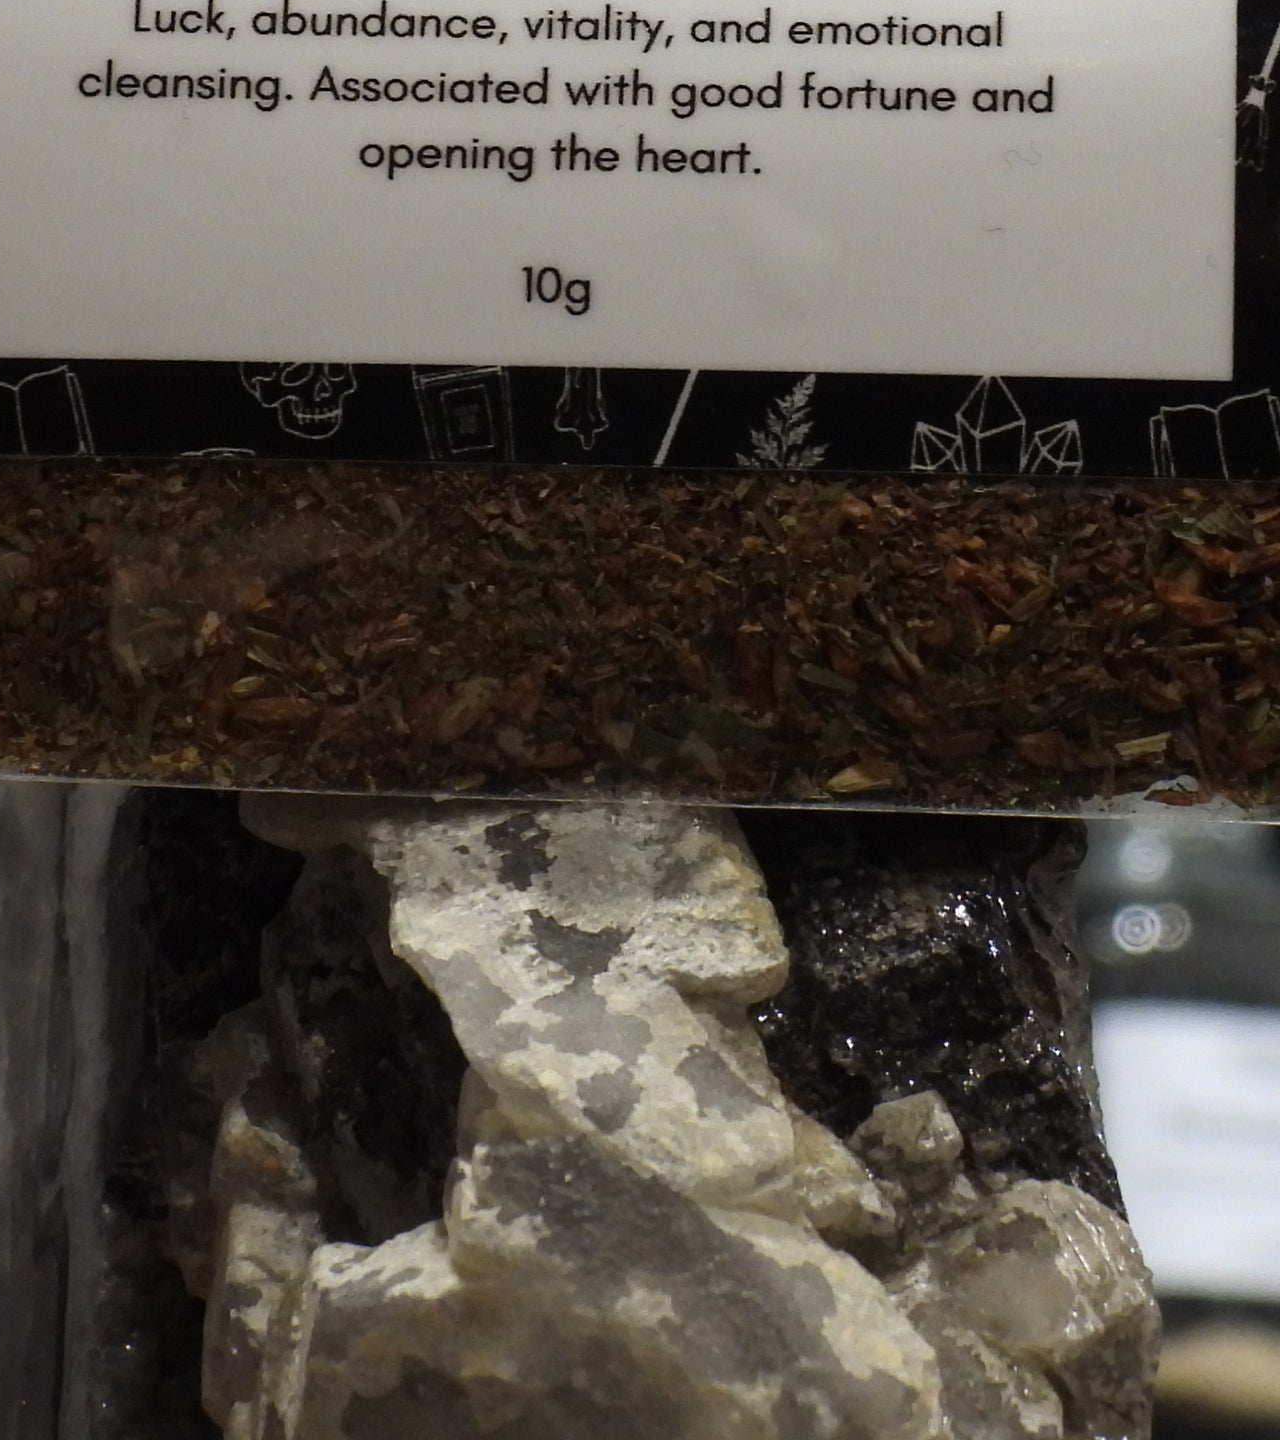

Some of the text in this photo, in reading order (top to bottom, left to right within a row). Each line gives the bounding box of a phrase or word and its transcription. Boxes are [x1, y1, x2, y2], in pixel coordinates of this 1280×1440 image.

[251, 0, 509, 47] abundance,
[523, 3, 675, 54] vitality,
[689, 6, 772, 45] and
[787, 10, 1004, 48] emotional
[77, 65, 1055, 120] cleansing. Associated with good fortune and
[358, 131, 762, 183] opening the heart.
[521, 265, 592, 317] 10g
